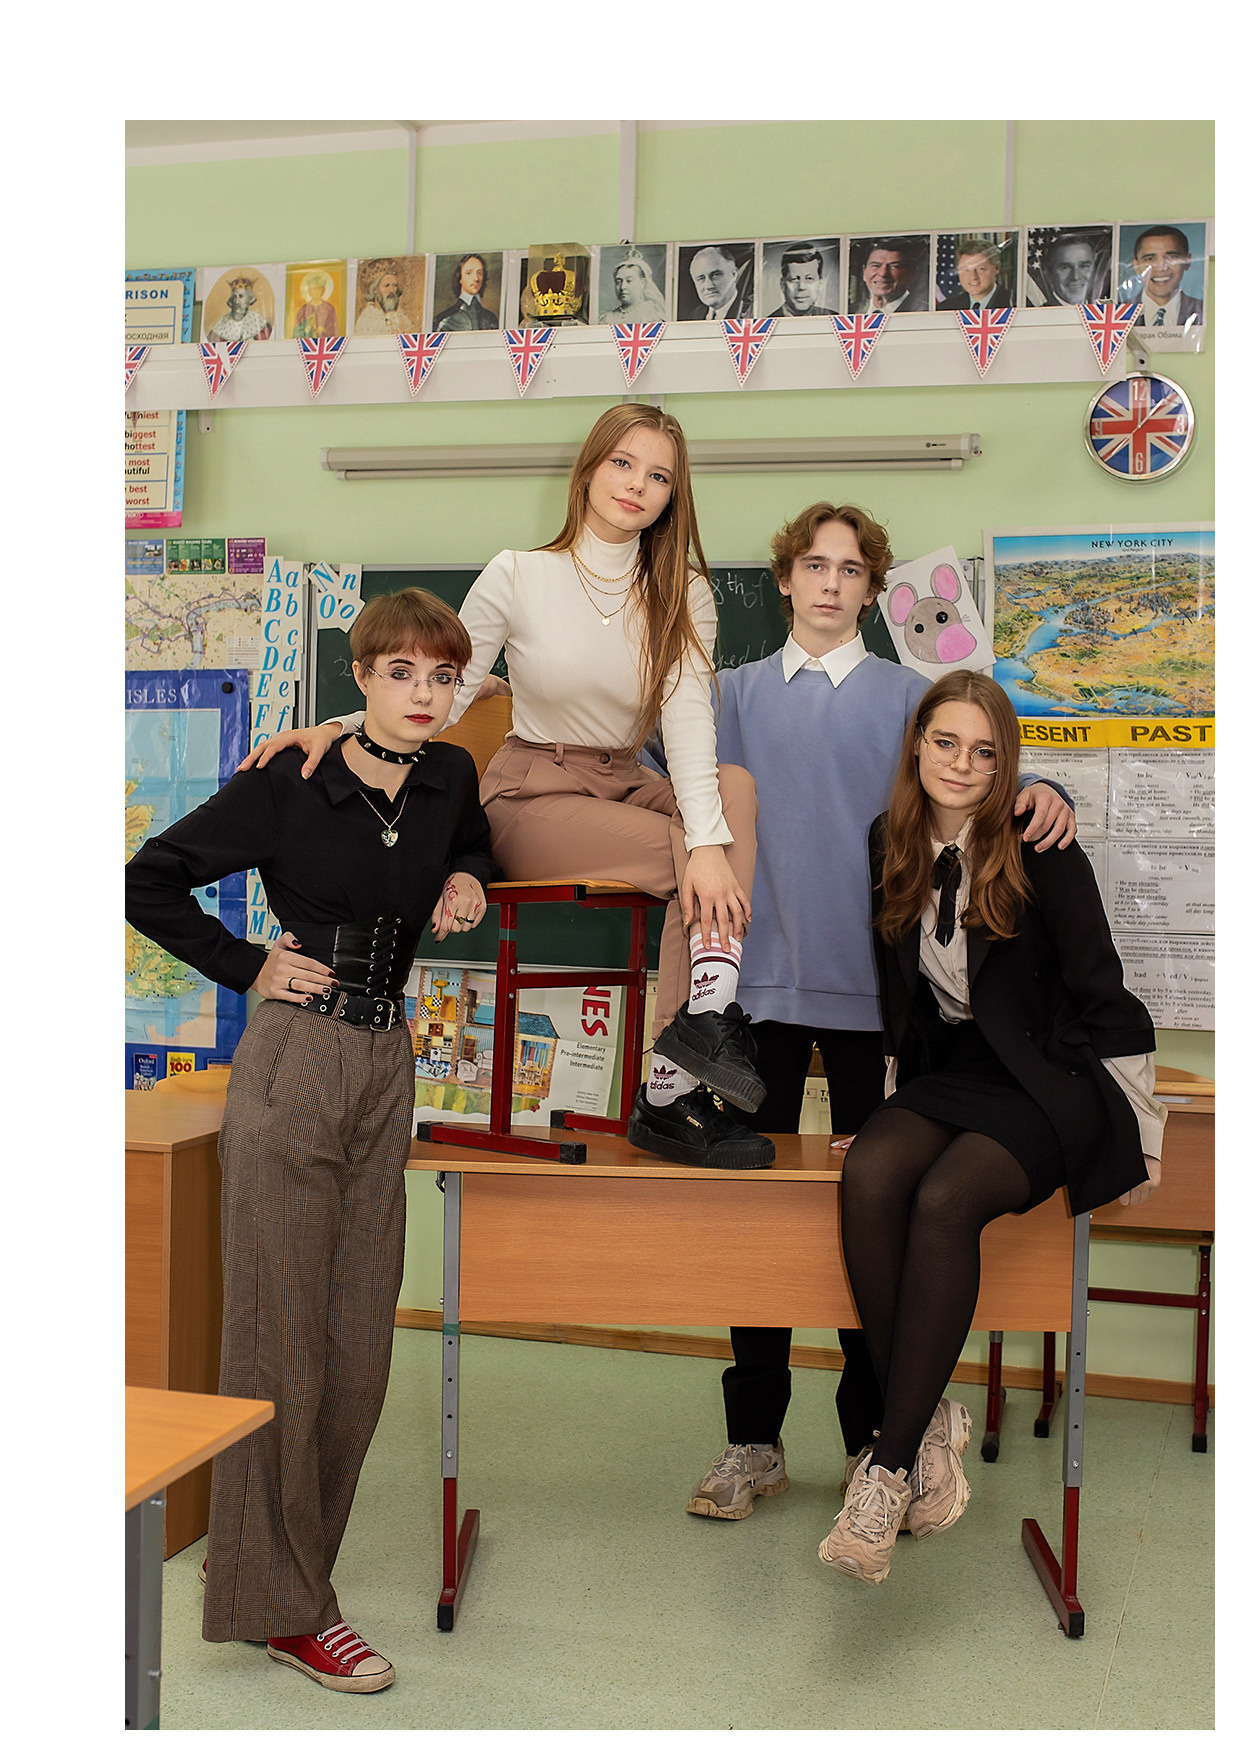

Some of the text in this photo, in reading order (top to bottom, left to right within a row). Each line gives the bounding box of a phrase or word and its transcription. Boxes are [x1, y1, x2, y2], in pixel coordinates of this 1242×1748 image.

[1157, 331, 1183, 339] Обама
[1132, 381, 1148, 401] 12
[1176, 414, 1185, 435] 3
[1134, 452, 1144, 473] 6
[129, 485, 148, 493] best
[125, 497, 150, 505] worst
[1091, 538, 1173, 548] NEW YORK CITY
[266, 558, 283, 584] A
[285, 570, 300, 589] a
[264, 588, 299, 618] B b
[263, 618, 282, 644] C
[261, 646, 297, 673] D d
[254, 673, 290, 699] E e
[126, 688, 178, 704] ISLES
[253, 703, 270, 729] F
[1130, 724, 1213, 742] PAST
[250, 881, 265, 907] L
[248, 910, 267, 935] M
[691, 987, 717, 1002] adidas
[560, 1049, 605, 1062] Pre-intermediate
[576, 1041, 606, 1054] Elementary
[169, 1062, 192, 1073] 100
[569, 1060, 604, 1071] Intermediate
